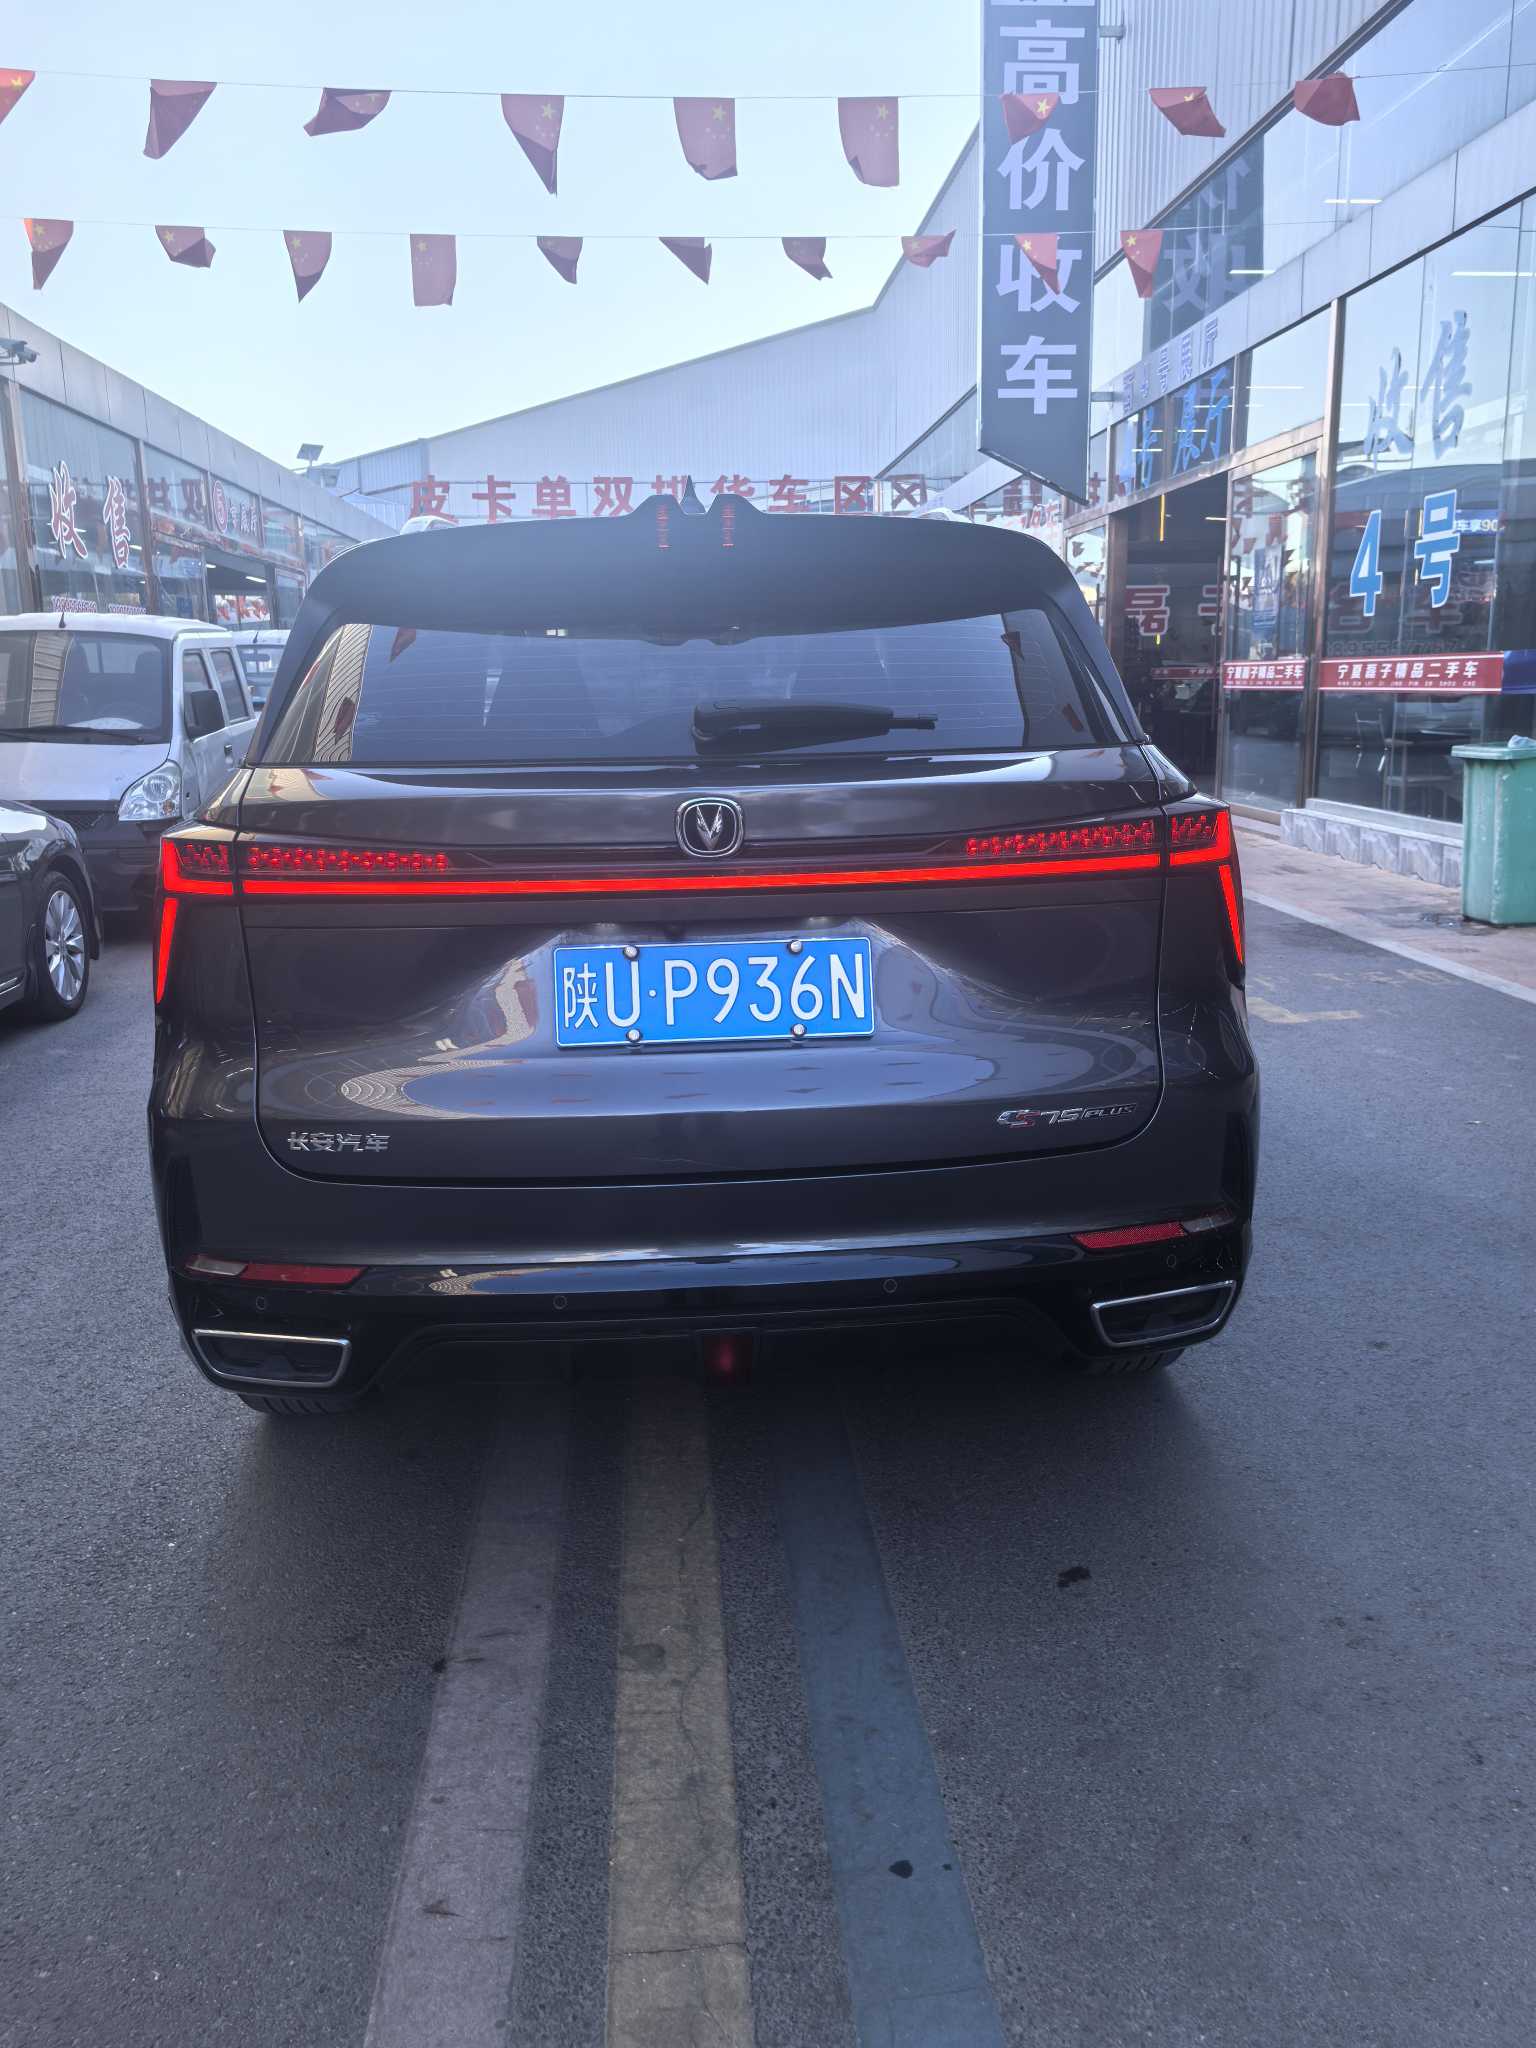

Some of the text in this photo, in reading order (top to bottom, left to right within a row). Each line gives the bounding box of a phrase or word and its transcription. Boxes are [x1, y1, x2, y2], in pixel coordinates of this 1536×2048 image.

[996, 19, 1086, 415] 高价收车
[1349, 489, 1460, 617] 4号
[562, 952, 866, 1029] 陕U·P936N
[287, 1131, 390, 1153] 长安汽车
